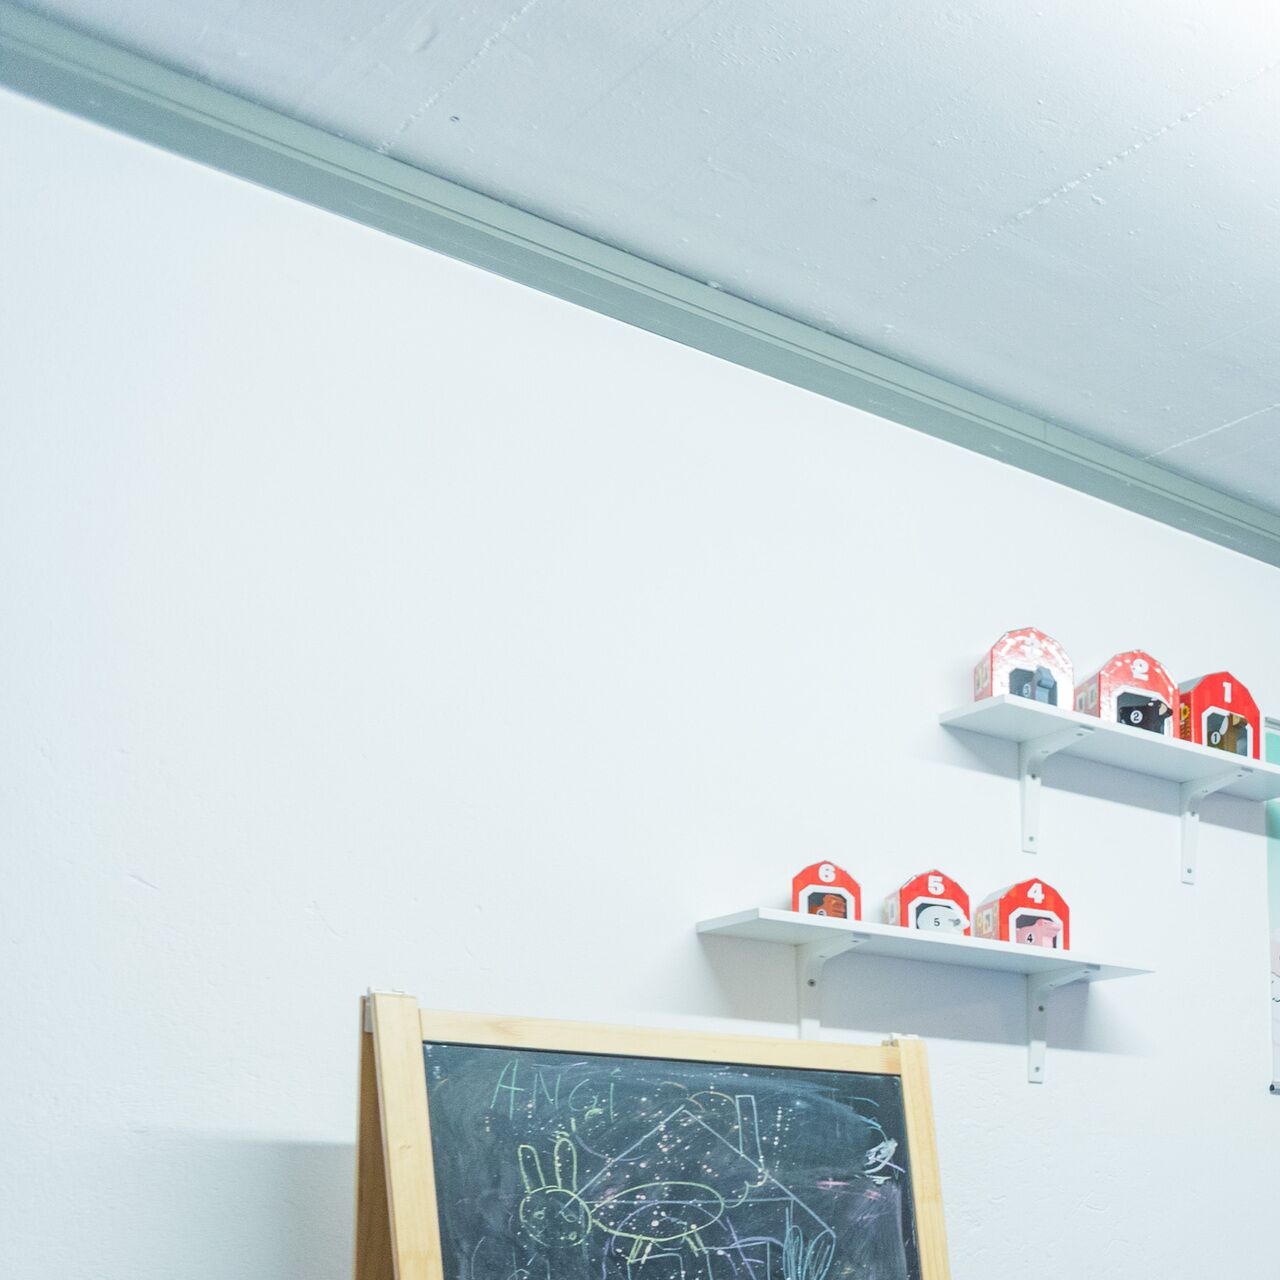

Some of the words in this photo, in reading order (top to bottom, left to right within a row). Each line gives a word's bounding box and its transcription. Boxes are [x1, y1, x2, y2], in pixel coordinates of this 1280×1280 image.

[1131, 658, 1149, 680] 2
[1222, 681, 1232, 703] 1
[1132, 711, 1141, 723] 2
[818, 863, 837, 883] 6
[927, 875, 945, 895] 5
[1027, 882, 1045, 904] 4
[934, 917, 940, 927] 5
[1027, 933, 1033, 943] 4
